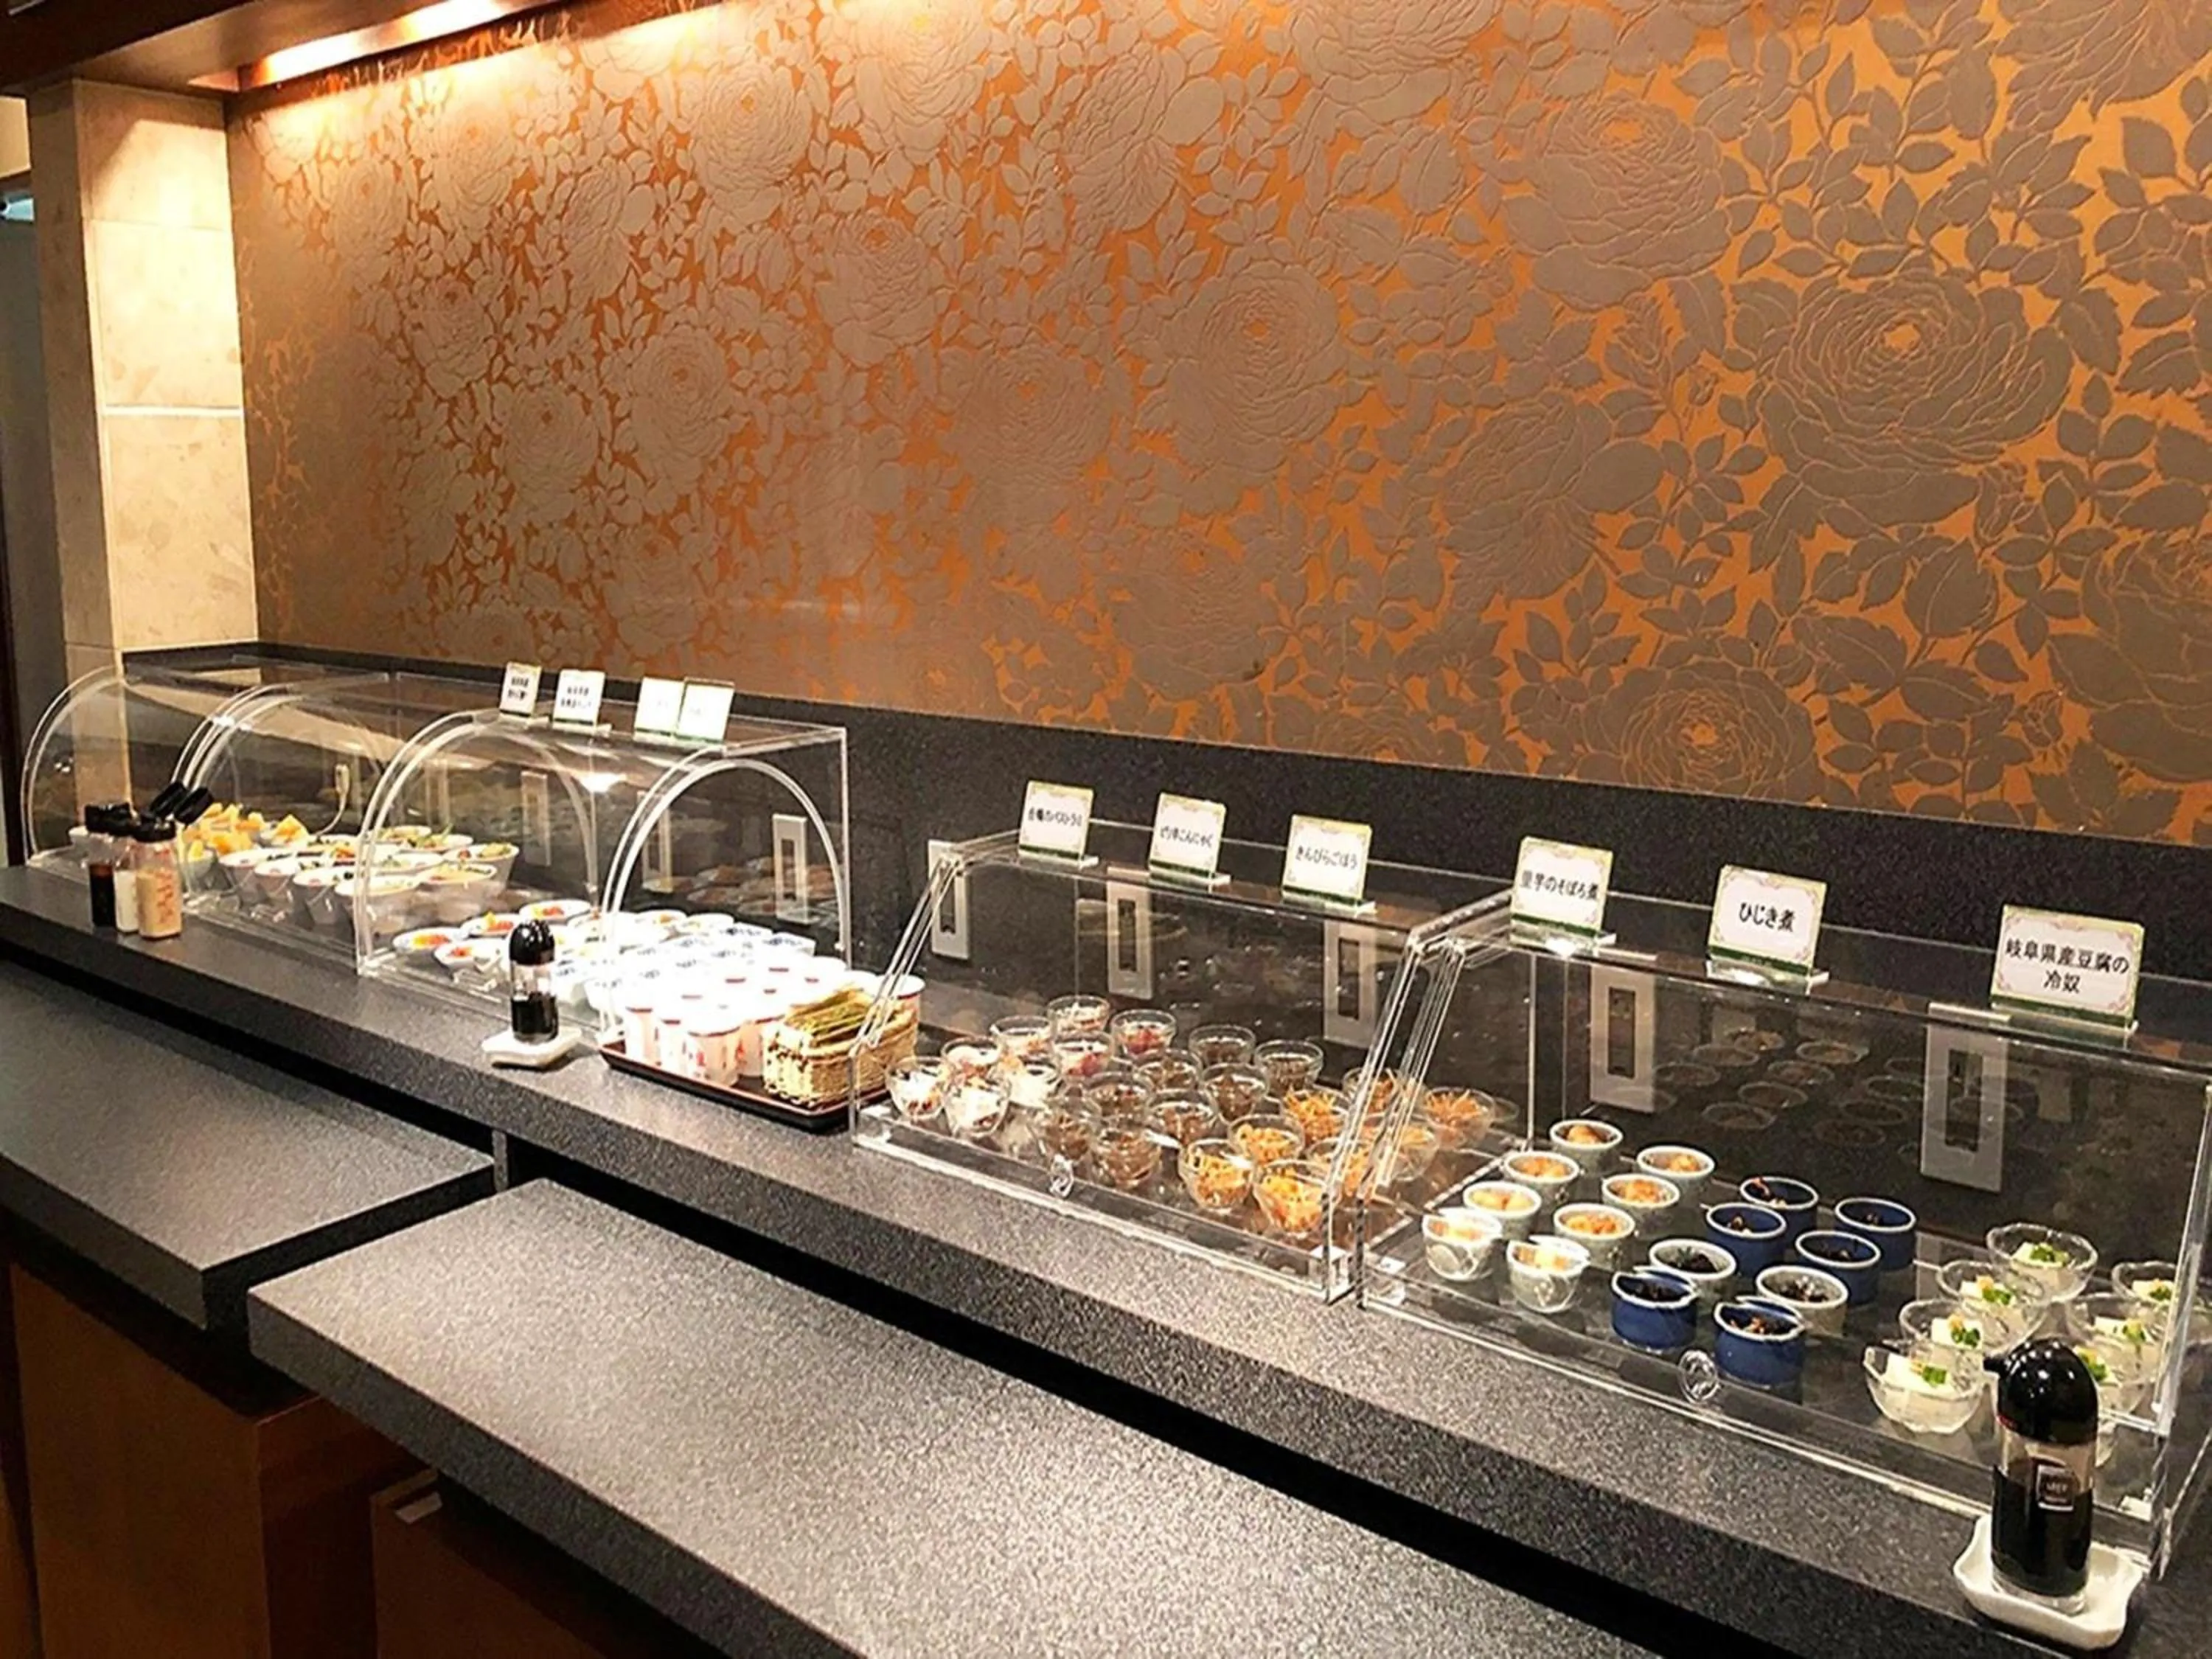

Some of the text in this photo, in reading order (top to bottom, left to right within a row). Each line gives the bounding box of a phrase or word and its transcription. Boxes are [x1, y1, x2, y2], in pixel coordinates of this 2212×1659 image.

[1739, 902, 1796, 933] ひじき煮
[2006, 937, 2130, 975] 岐阜県産豆腐の
[2042, 969, 2081, 994] 冷奴
